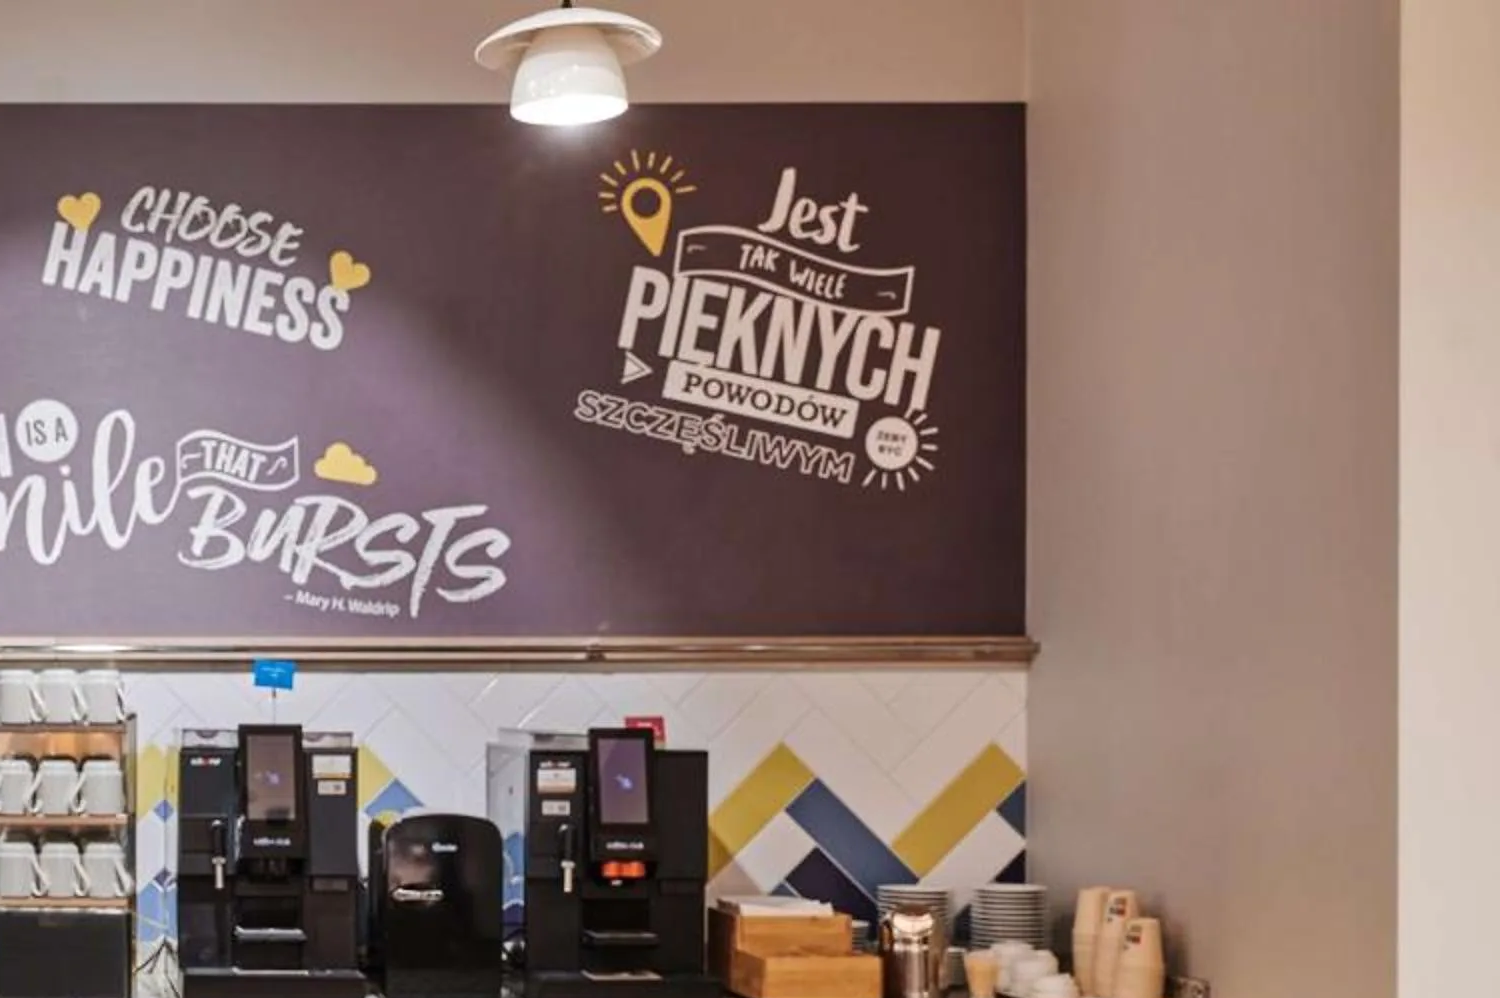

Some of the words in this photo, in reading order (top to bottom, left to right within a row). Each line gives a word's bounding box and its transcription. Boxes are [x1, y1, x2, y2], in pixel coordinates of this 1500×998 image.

[120, 185, 304, 267] CHOOSE
[758, 166, 869, 253] Jest
[42, 220, 350, 350] HAPPINESS
[739, 243, 781, 273] TAK
[789, 259, 848, 300] WIELE
[25, 419, 48, 447] IS
[55, 416, 69, 443] A
[200, 439, 268, 482] THAT
[296, 589, 330, 612] Mary
